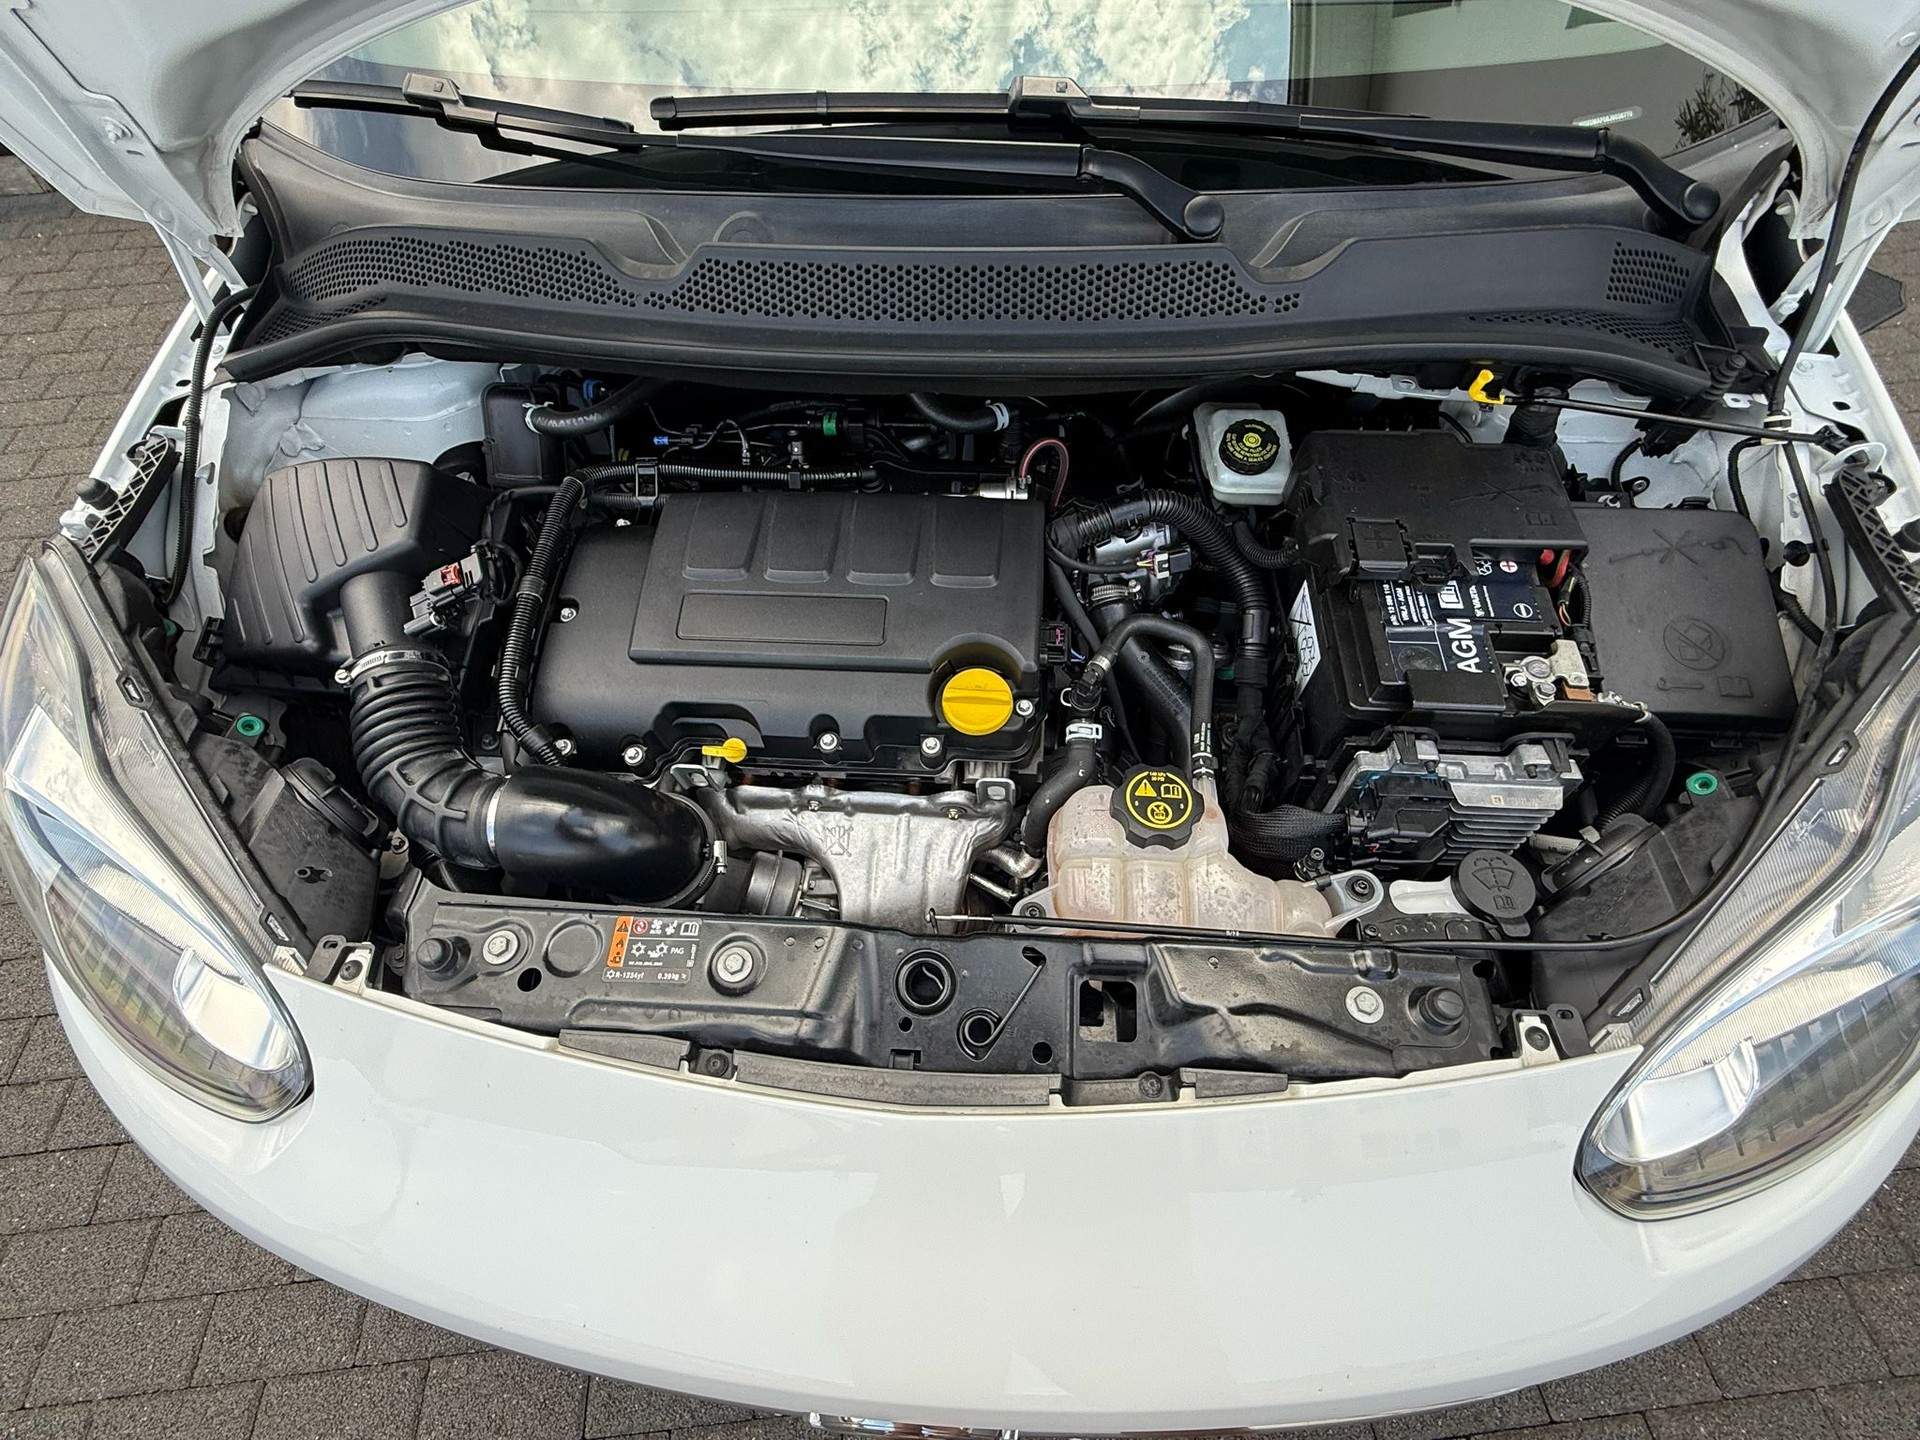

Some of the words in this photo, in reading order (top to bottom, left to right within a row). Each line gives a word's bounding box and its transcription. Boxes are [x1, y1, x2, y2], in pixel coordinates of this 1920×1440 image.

[1469, 585, 1482, 609] VARTA
[1446, 618, 1483, 674] AGM
[670, 947, 685, 955] PAG
[615, 971, 645, 980] R-1234yf
